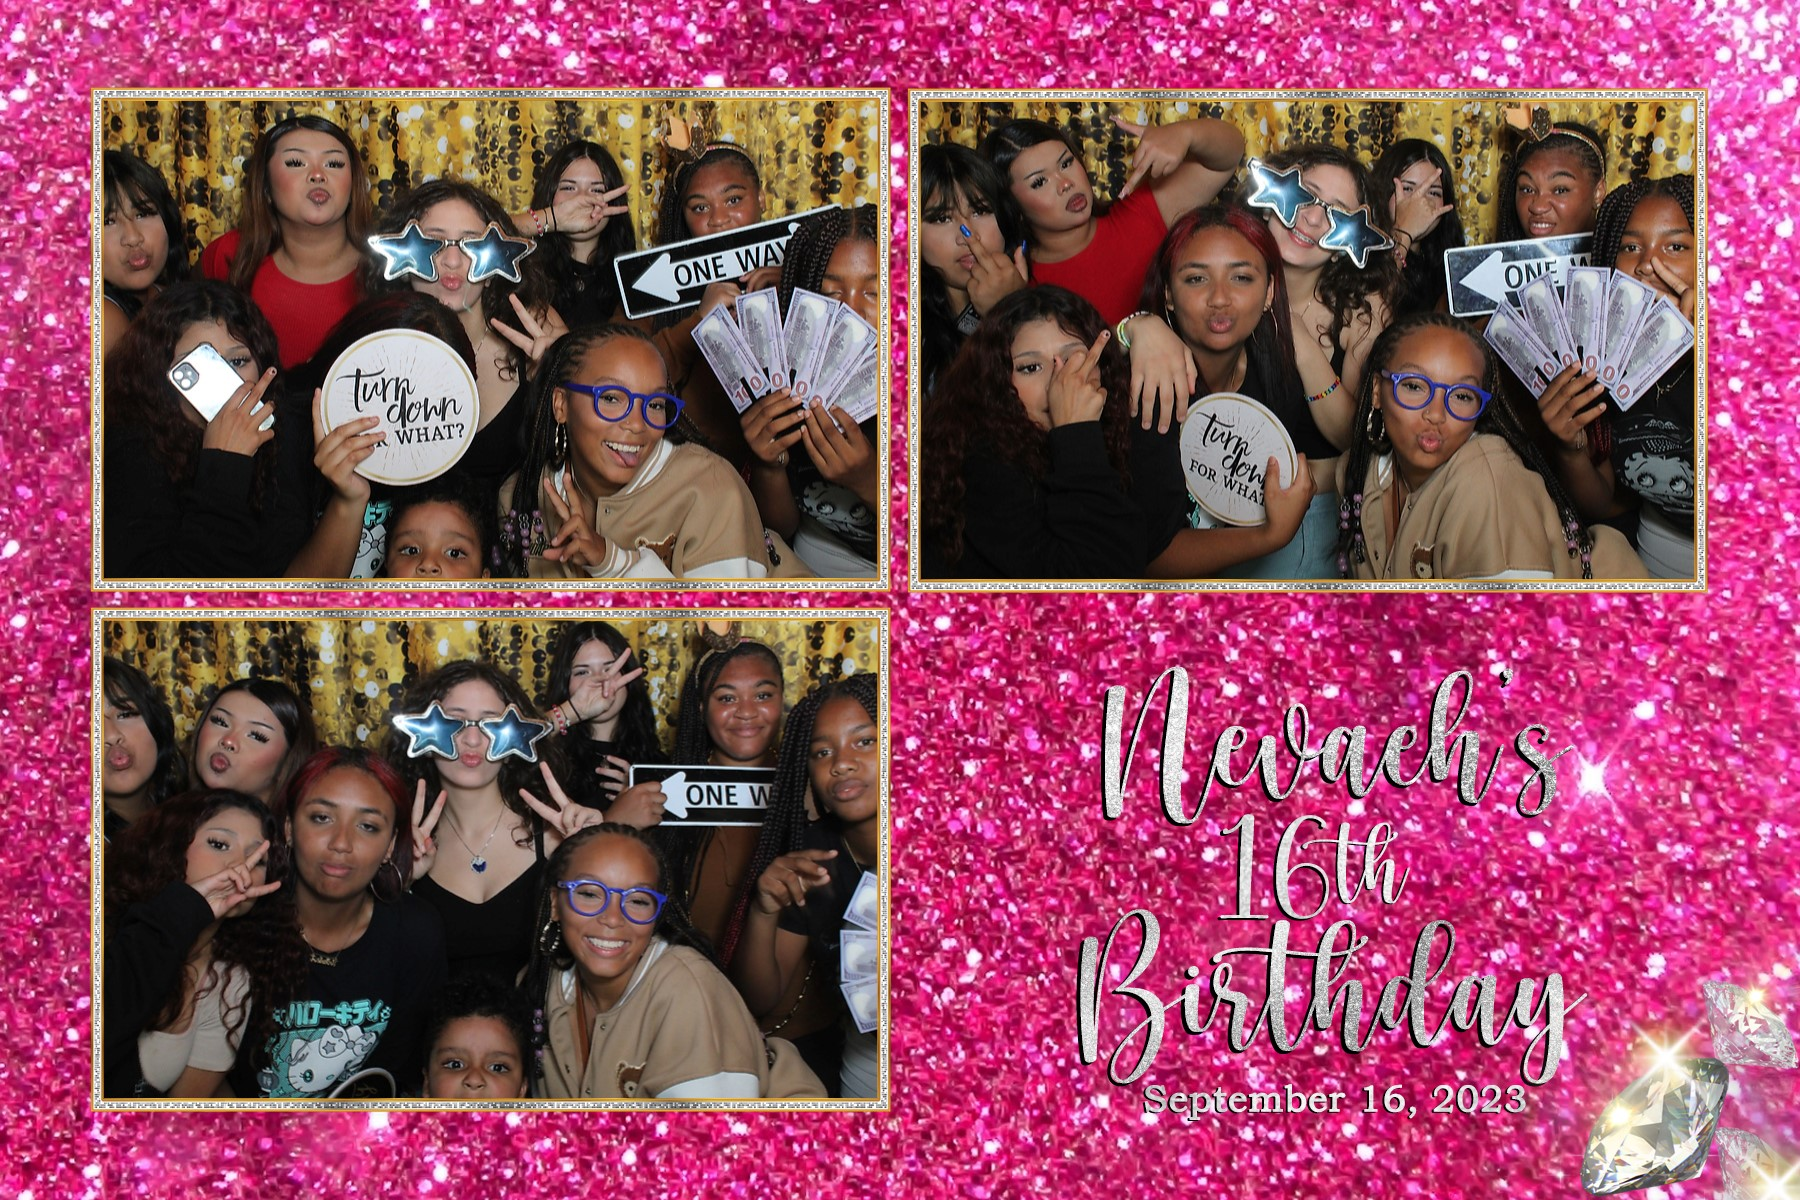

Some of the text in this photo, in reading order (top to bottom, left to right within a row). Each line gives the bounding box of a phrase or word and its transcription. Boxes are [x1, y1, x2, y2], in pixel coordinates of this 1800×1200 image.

[674, 255, 727, 287] ONE
[336, 368, 416, 413] turn
[386, 387, 463, 429] down
[395, 423, 465, 445] WHAT?
[1196, 412, 1252, 457] turn
[1189, 459, 1265, 507] FOR WHAT
[1221, 447, 1266, 492] dow
[686, 784, 738, 806] ONE
